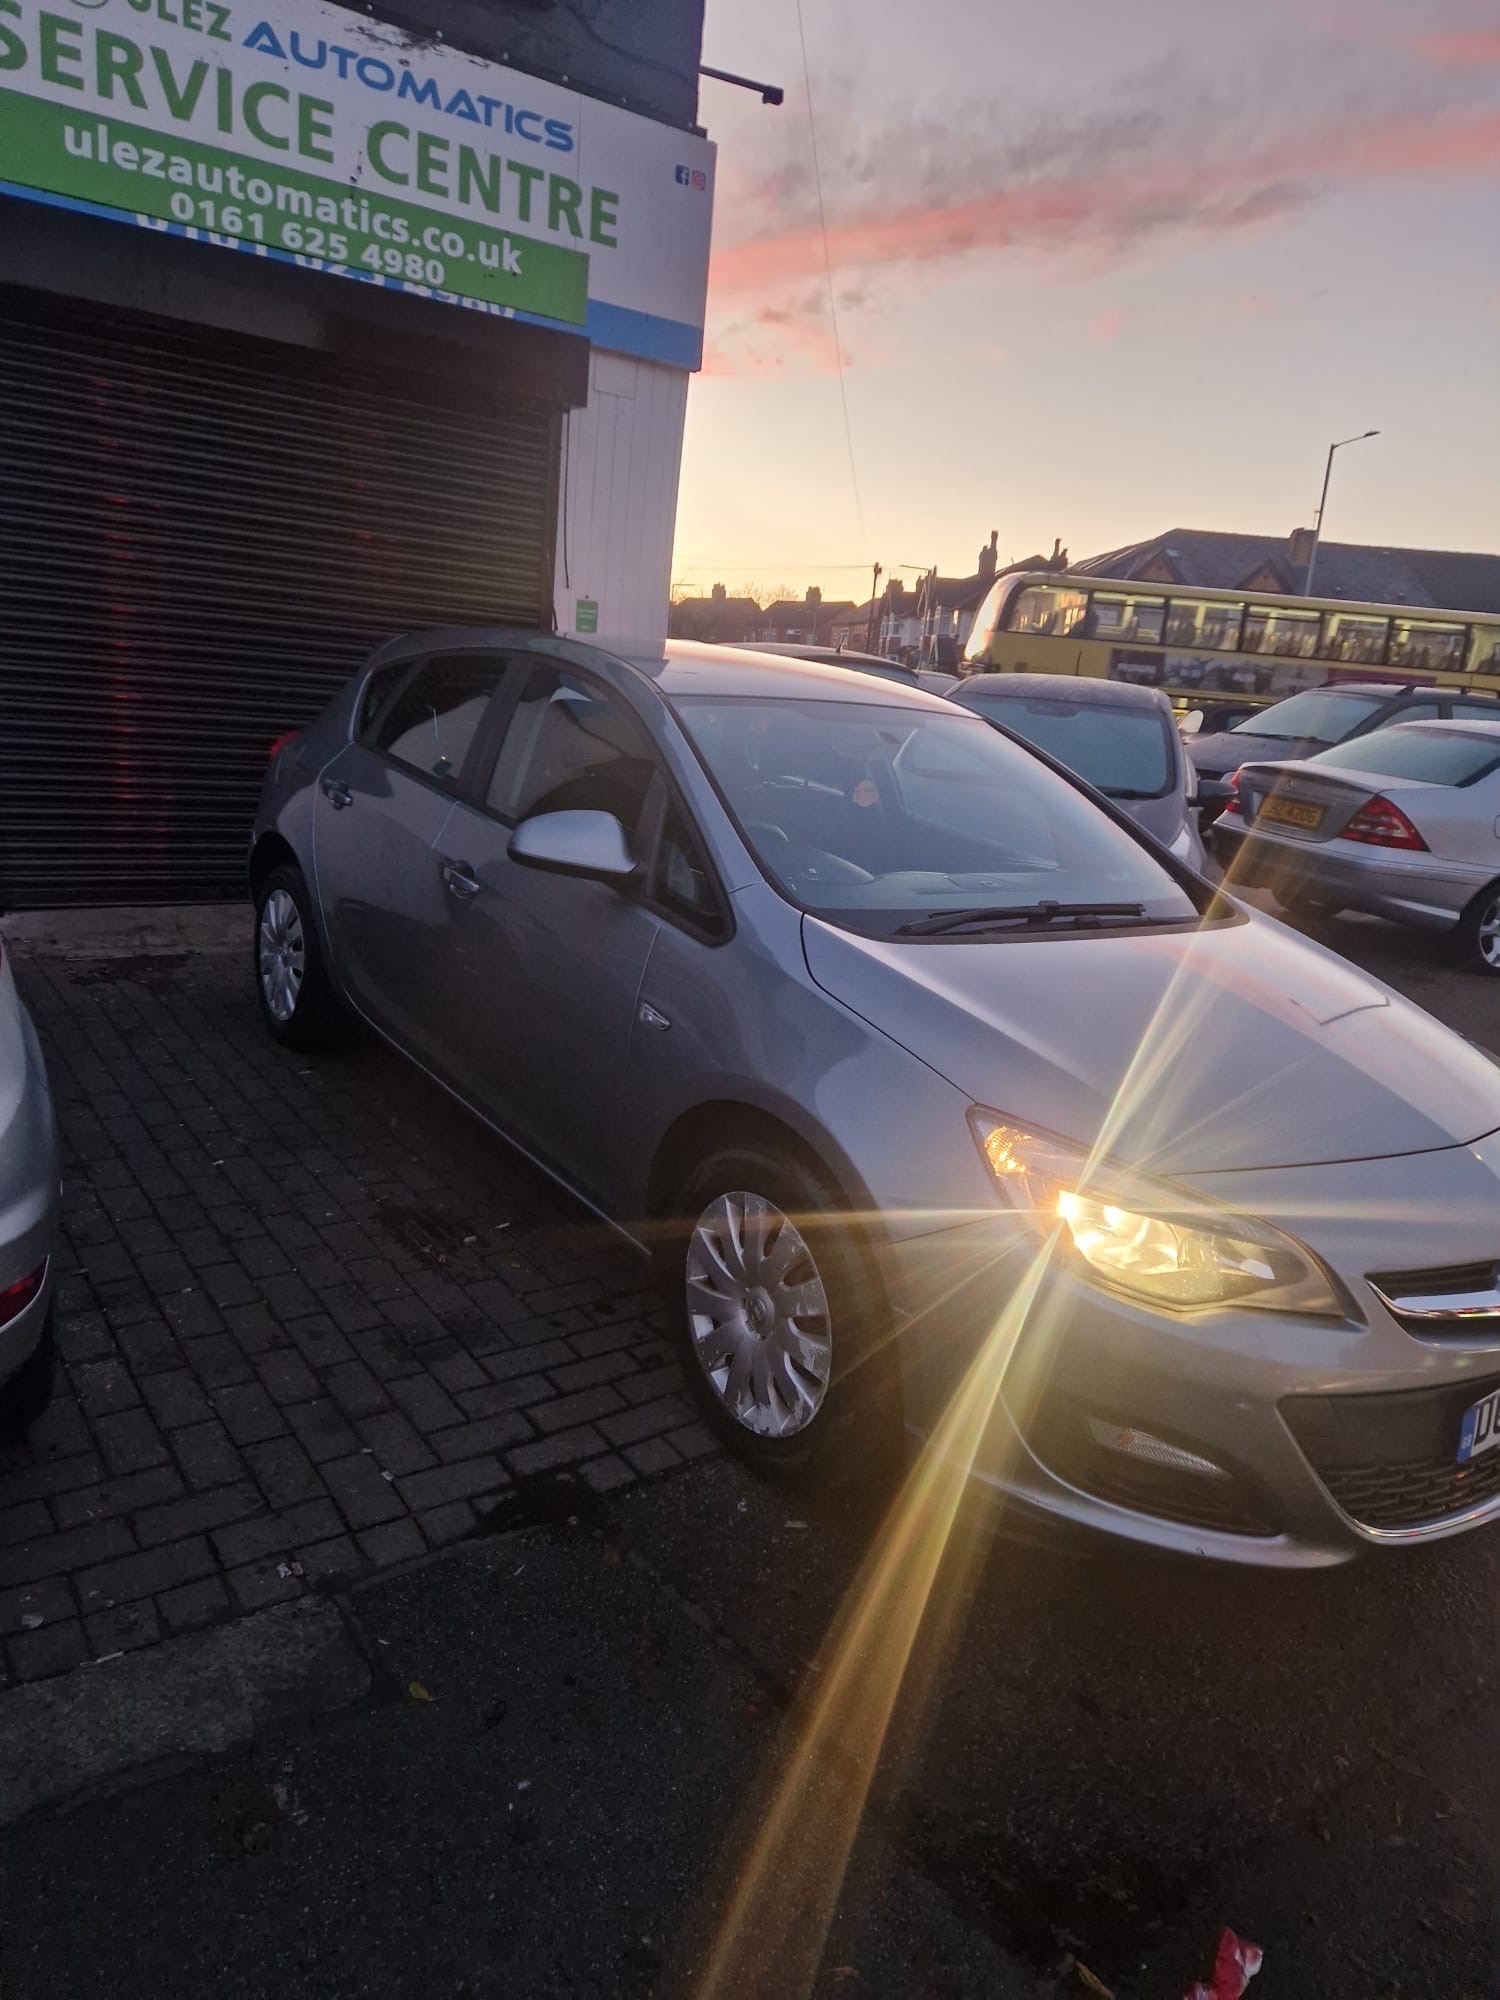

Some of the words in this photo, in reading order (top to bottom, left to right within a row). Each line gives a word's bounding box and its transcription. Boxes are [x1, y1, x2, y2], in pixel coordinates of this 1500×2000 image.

[242, 21, 574, 152] AUTOMATICS
[64, 124, 522, 275] ulezautomatics.co.uk
[170, 193, 264, 240] 0161
[281, 222, 348, 260] 625
[361, 244, 445, 286] 4980
[366, 120, 619, 248] CENTRE
